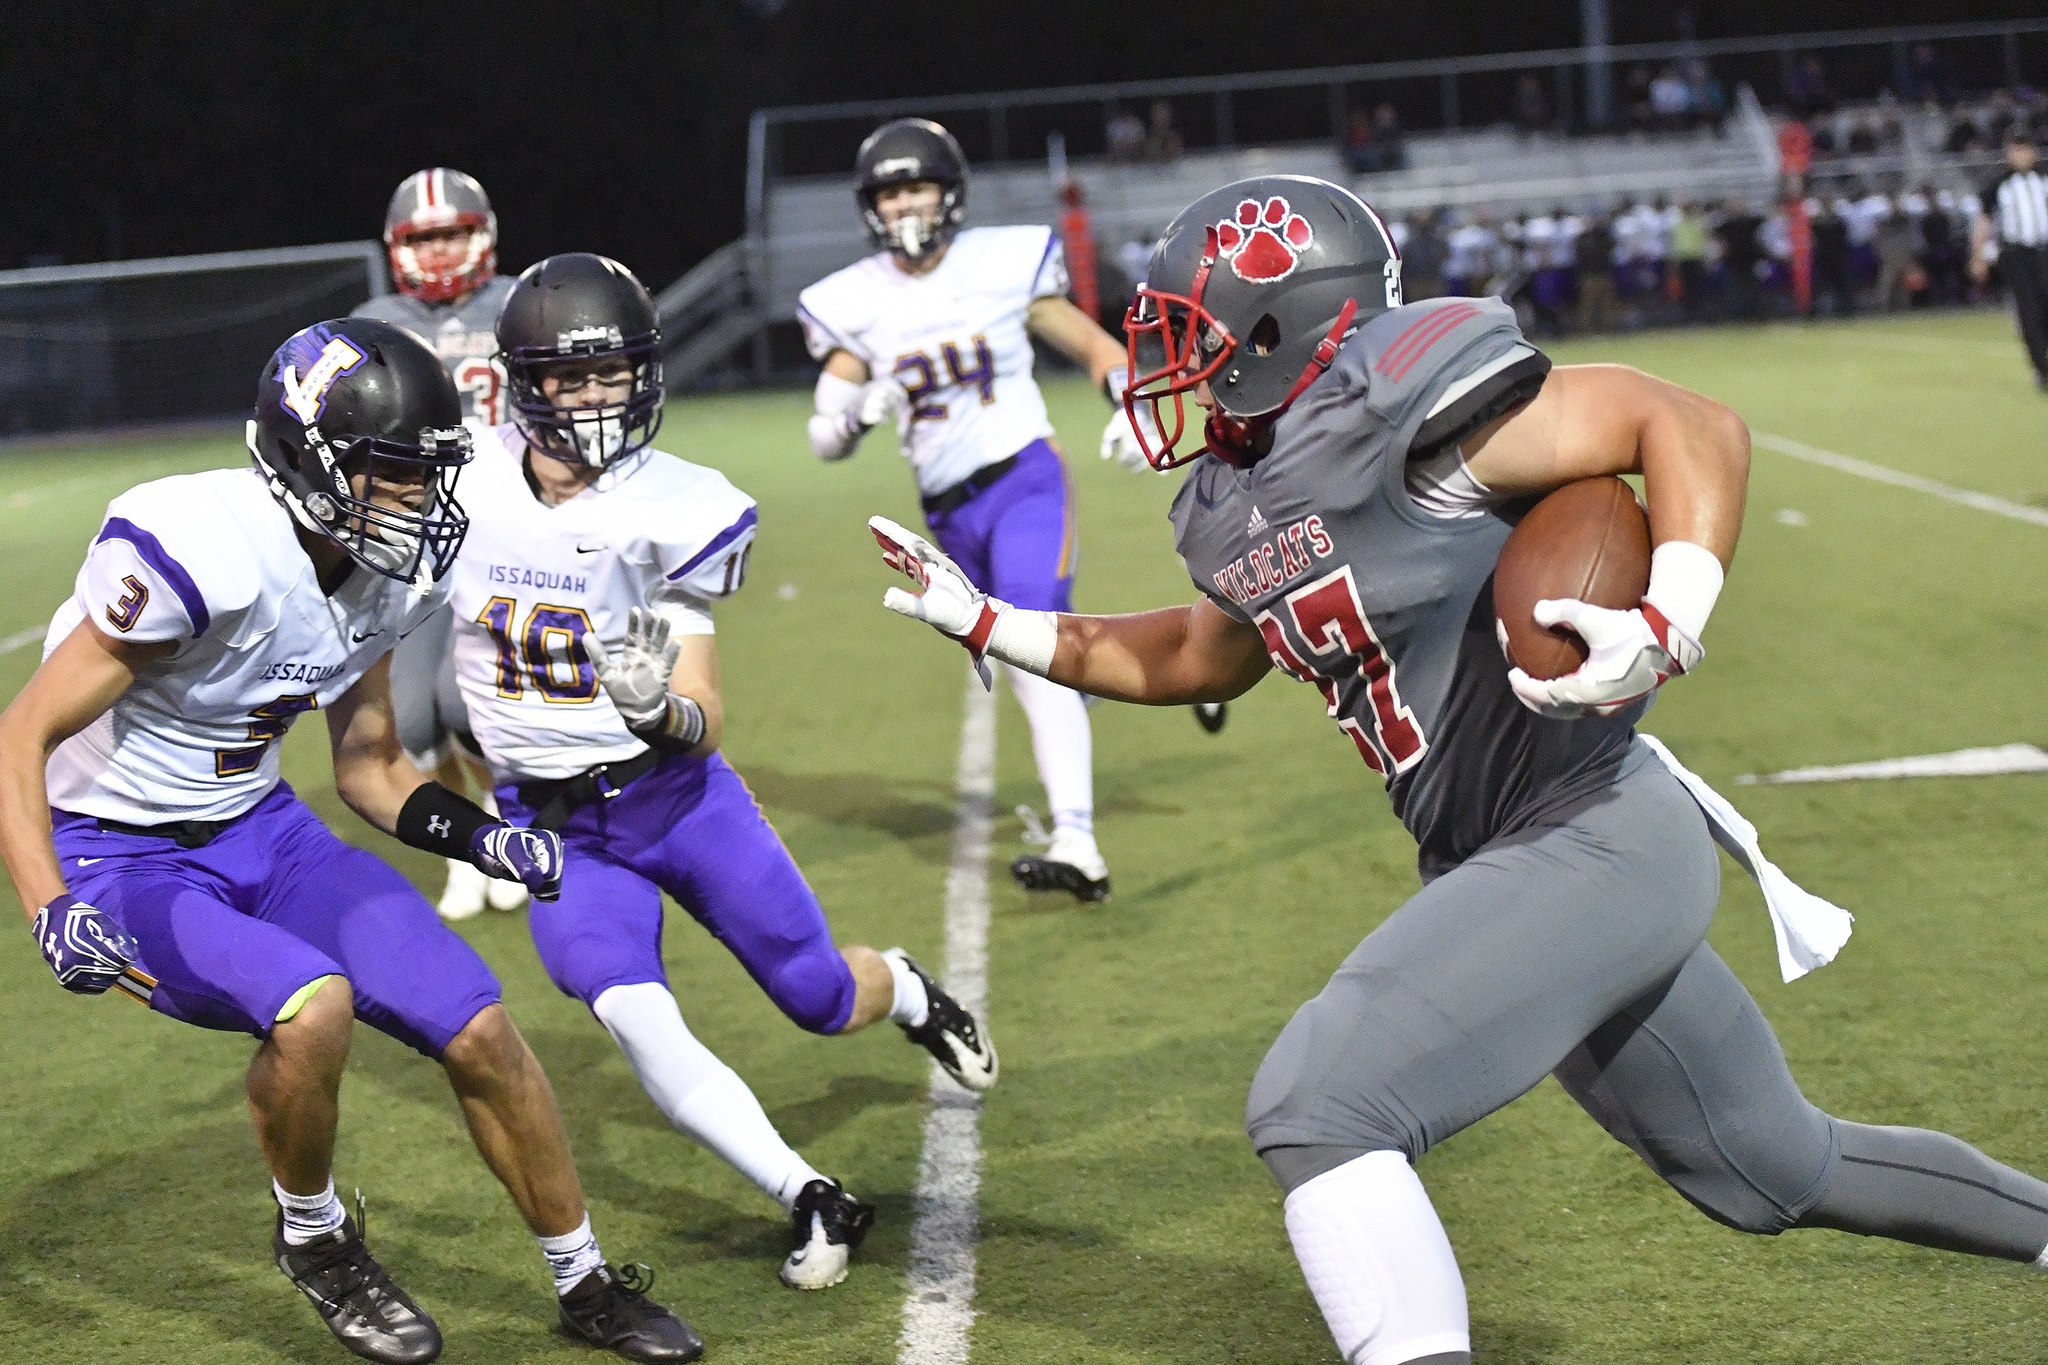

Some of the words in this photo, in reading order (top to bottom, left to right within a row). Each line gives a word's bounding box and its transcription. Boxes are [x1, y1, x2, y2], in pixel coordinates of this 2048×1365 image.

[893, 333, 996, 422] 24
[106, 574, 149, 633] 3
[488, 564, 586, 593] ISSAQUAH
[1213, 514, 1334, 606] WILDCATS
[476, 595, 599, 705] 10
